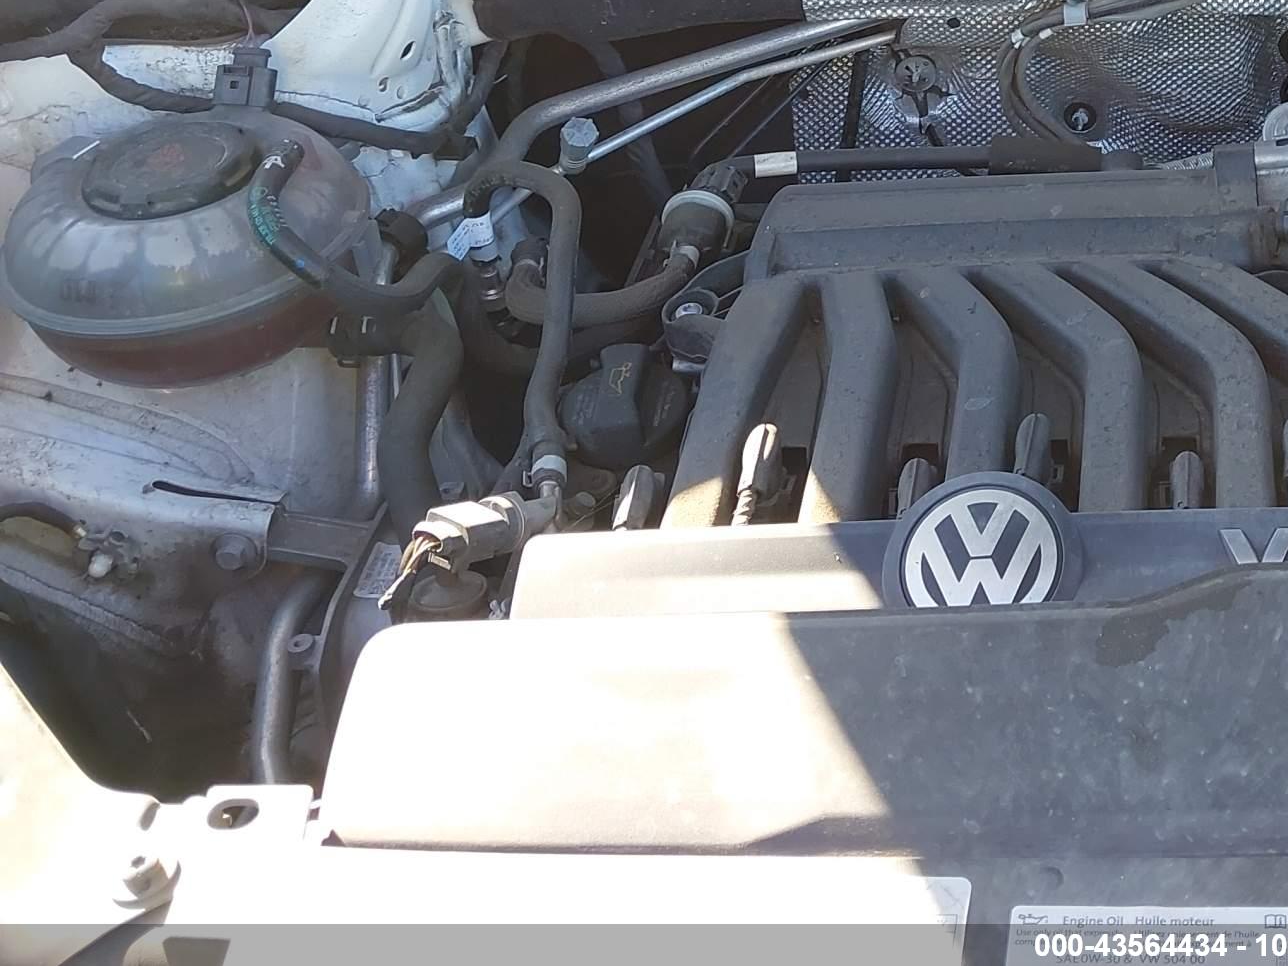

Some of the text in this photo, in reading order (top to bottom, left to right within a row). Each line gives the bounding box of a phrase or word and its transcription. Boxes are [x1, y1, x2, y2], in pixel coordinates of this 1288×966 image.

[1063, 915, 1215, 928] Engine Oil Huile moteur
